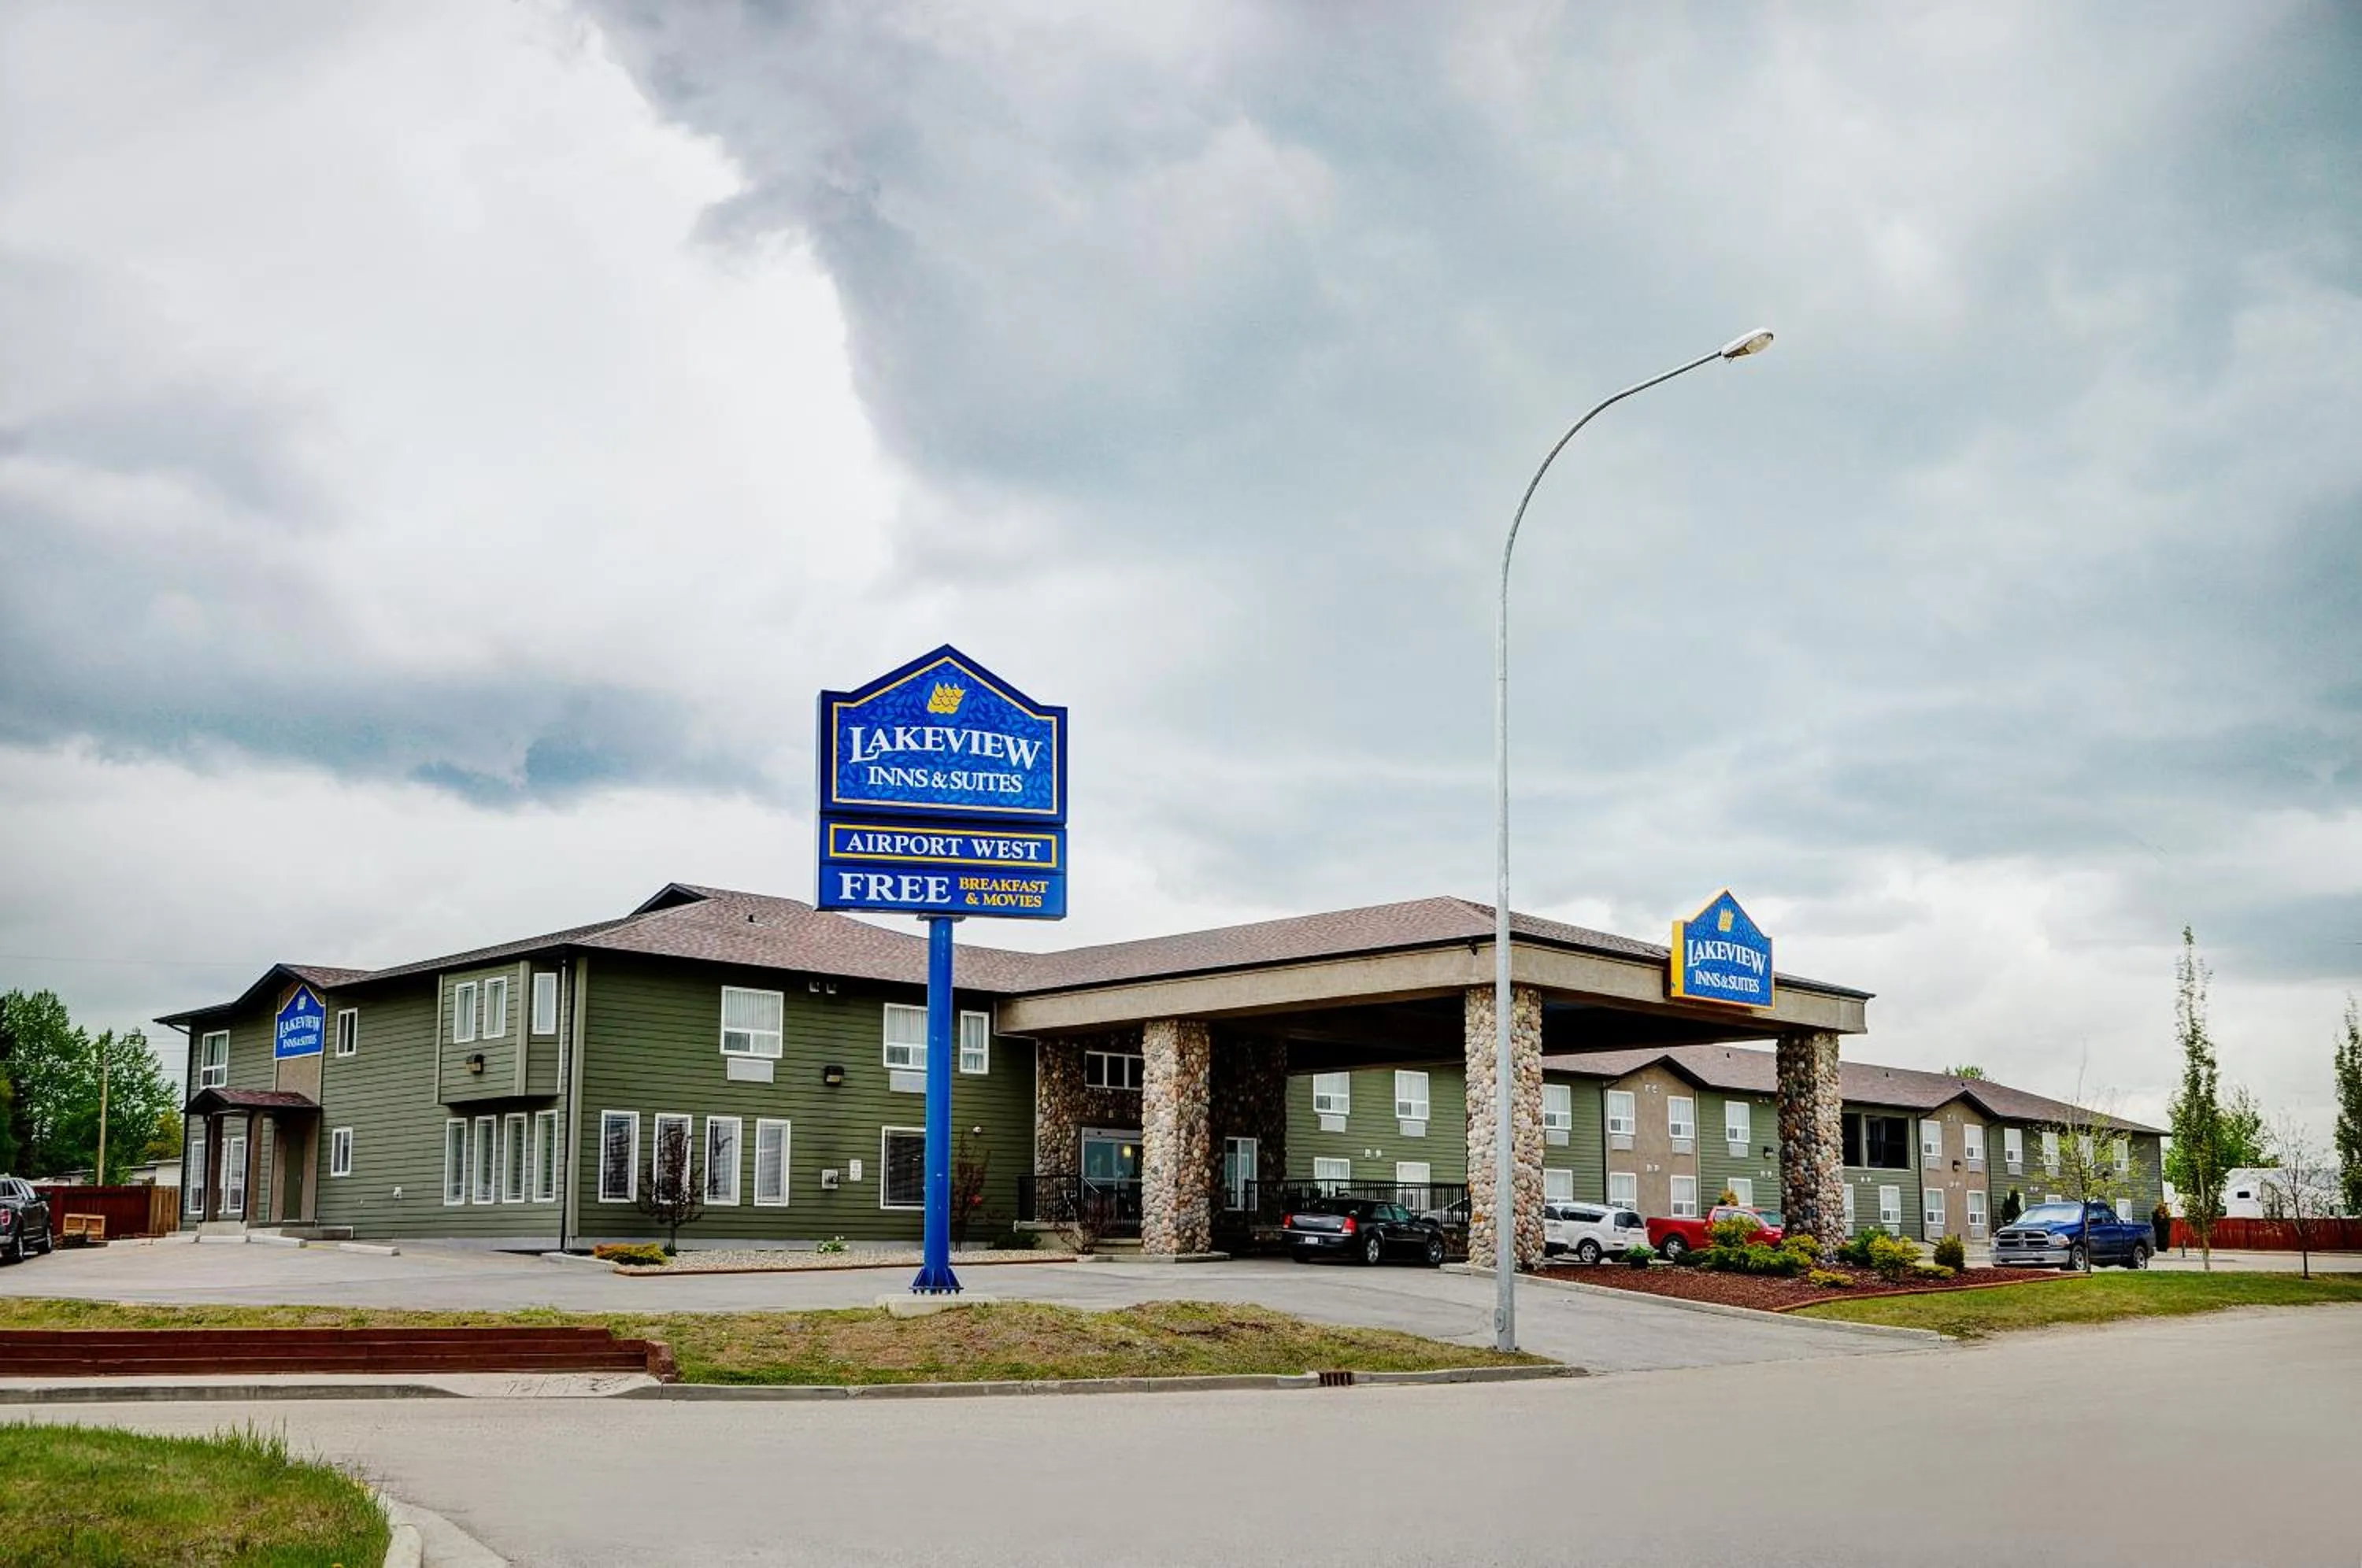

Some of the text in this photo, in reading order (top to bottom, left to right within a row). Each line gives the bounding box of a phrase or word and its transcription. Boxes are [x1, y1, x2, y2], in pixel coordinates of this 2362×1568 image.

[849, 727, 1042, 770] LAKEVIEW
[868, 766, 927, 788] INNS
[951, 771, 1023, 792] SUITES
[846, 833, 1042, 860] AIRPORT WEST
[839, 872, 952, 903] FREE
[959, 877, 1049, 893] BREAKFAST
[965, 893, 1042, 908] & MOVIES
[1687, 940, 1767, 976] LAKEVIEW
[279, 1015, 322, 1039] LAKEVIEW
